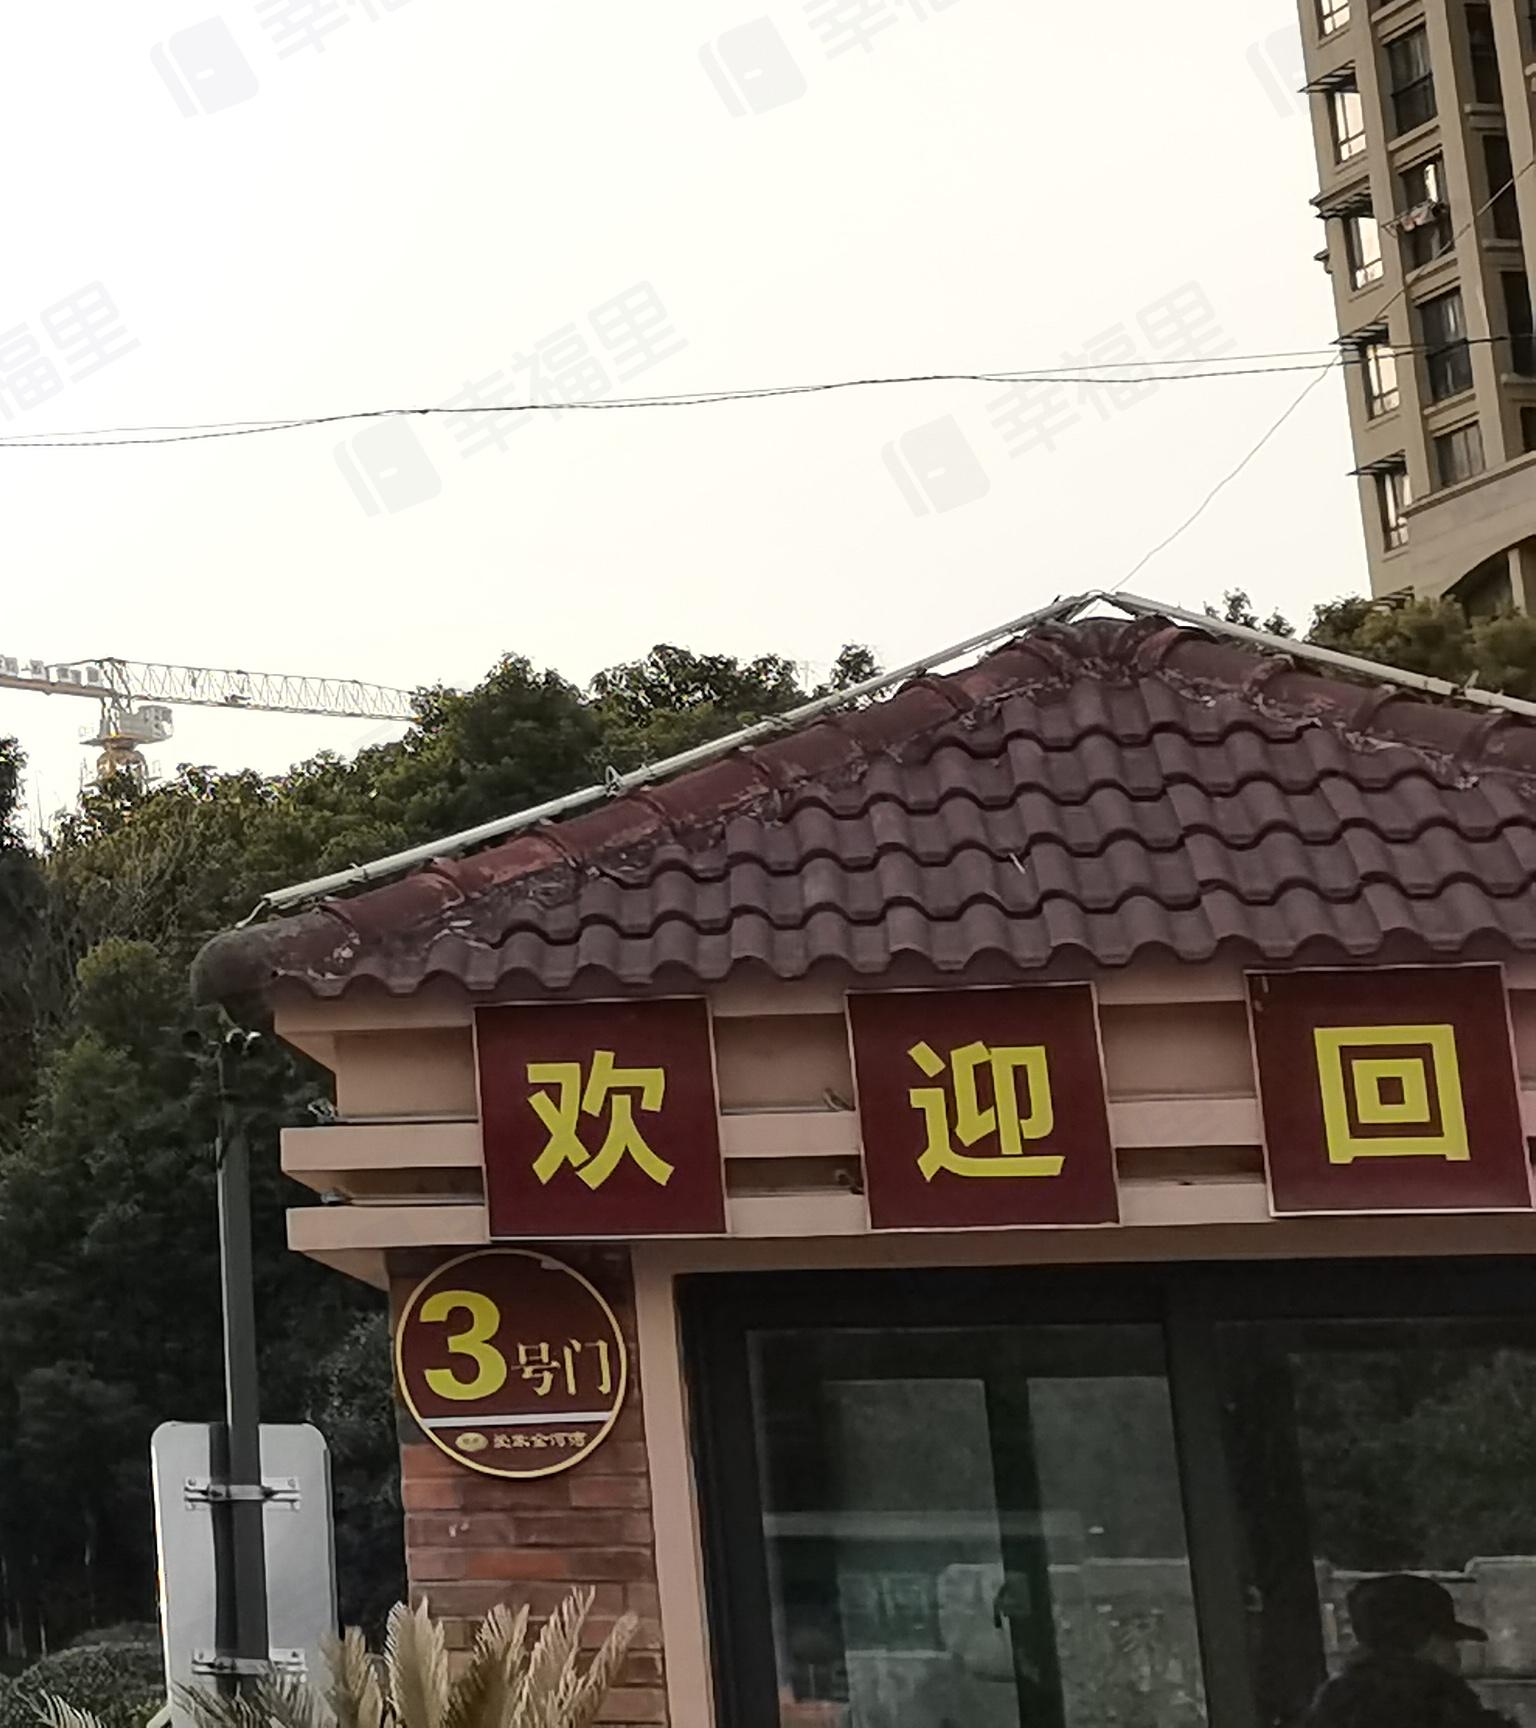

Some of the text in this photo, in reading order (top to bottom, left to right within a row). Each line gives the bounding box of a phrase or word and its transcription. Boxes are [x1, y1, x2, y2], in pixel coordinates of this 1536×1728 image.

[527, 1024, 1471, 1190] 欢迎回
[420, 1290, 612, 1401] 3号门
